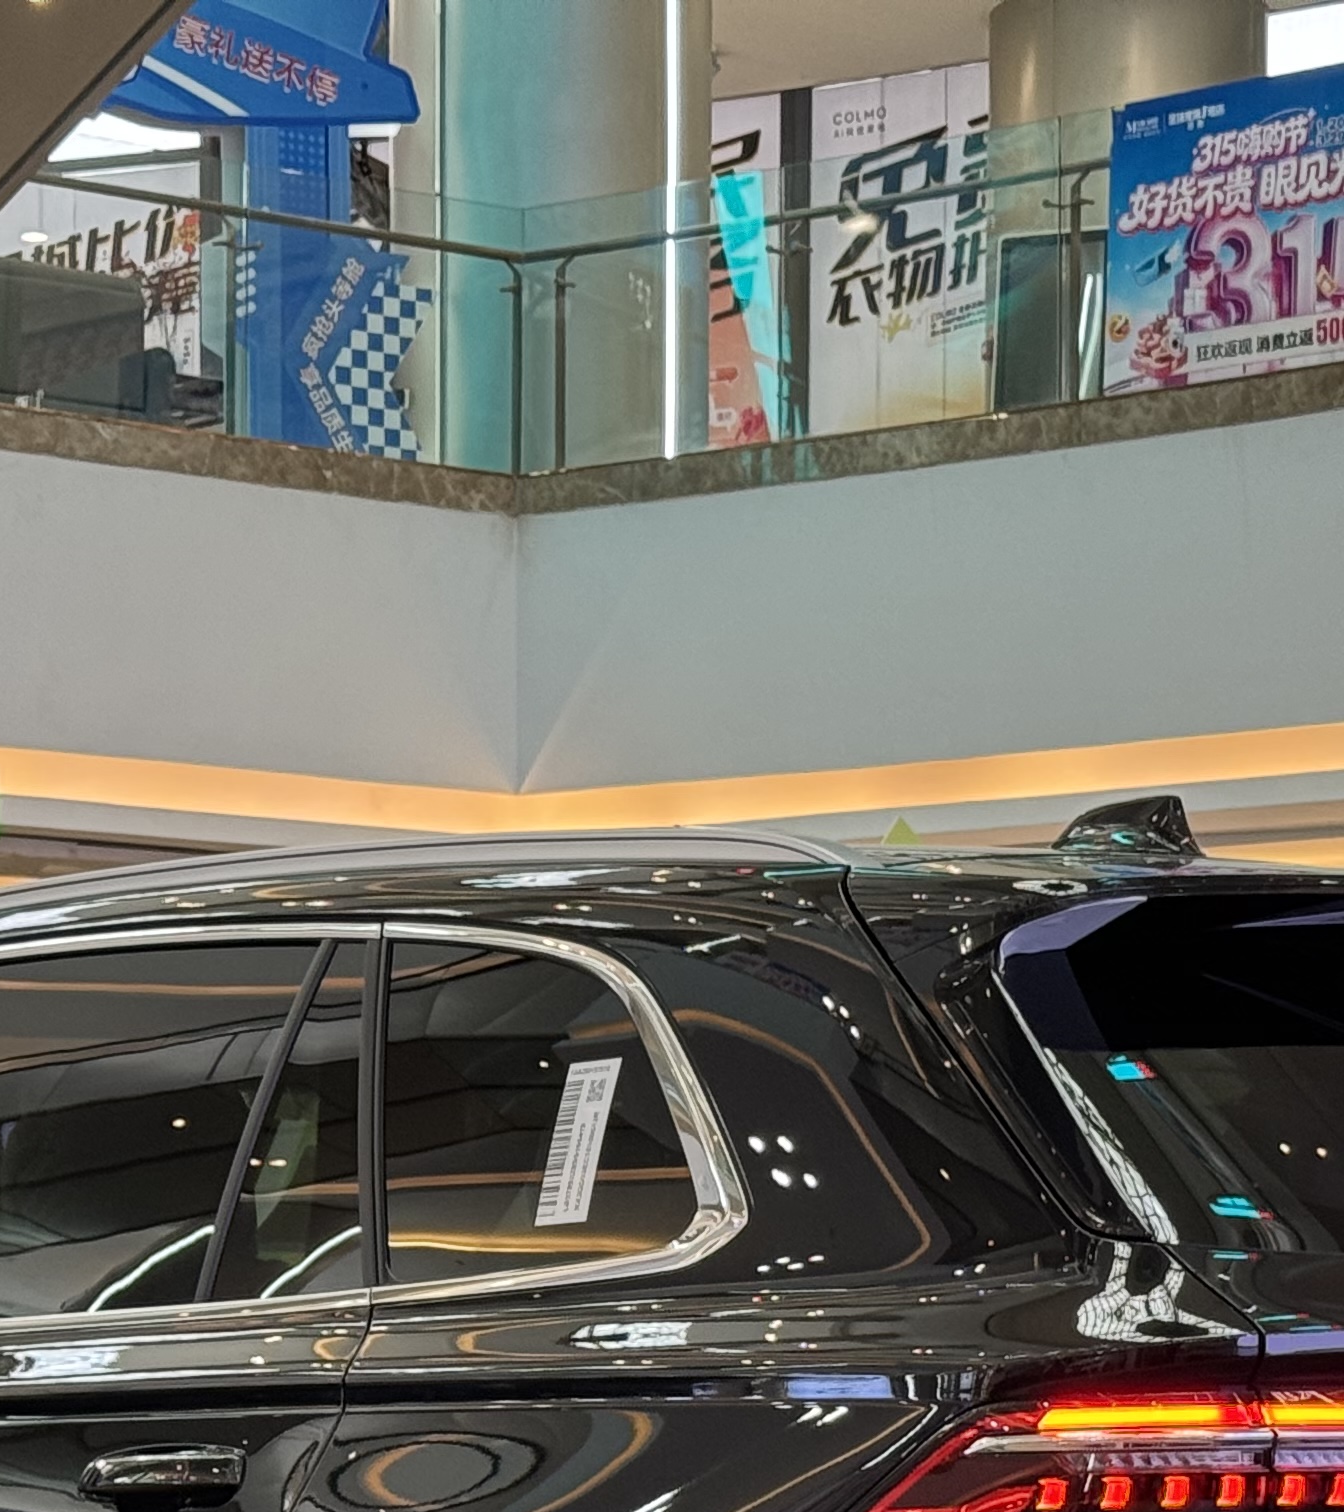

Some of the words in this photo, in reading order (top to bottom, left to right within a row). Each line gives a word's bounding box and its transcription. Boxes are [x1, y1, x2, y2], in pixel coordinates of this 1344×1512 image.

[173, 15, 341, 107] 豪礼送不停
[833, 105, 887, 126] COLMO
[1118, 164, 1256, 233] 好货不贵
